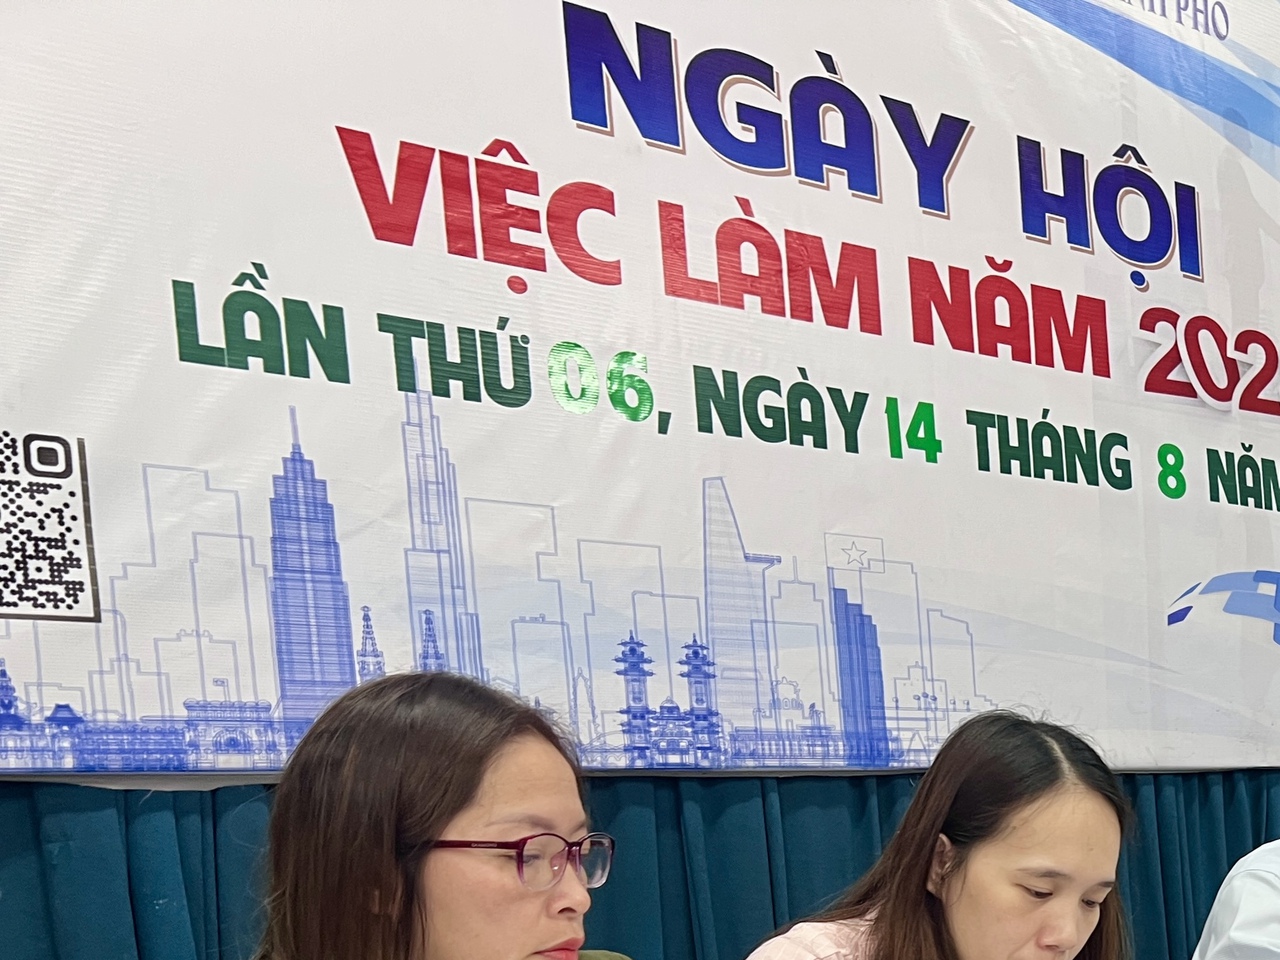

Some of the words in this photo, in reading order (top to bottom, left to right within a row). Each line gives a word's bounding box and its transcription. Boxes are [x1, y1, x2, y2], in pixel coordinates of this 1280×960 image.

[335, 126, 622, 295] VIỆC
[658, 196, 882, 336] LÀM
[907, 255, 1111, 379] NĂM
[562, 1, 974, 218] NGÀY
[1015, 135, 1203, 292] HỘI
[172, 262, 351, 384] LẦN
[376, 317, 532, 409] THỨ
[692, 365, 869, 454] NGÀY
[885, 396, 942, 464] 14
[965, 408, 1133, 491] THÁNG
[1157, 444, 1186, 499] 8
